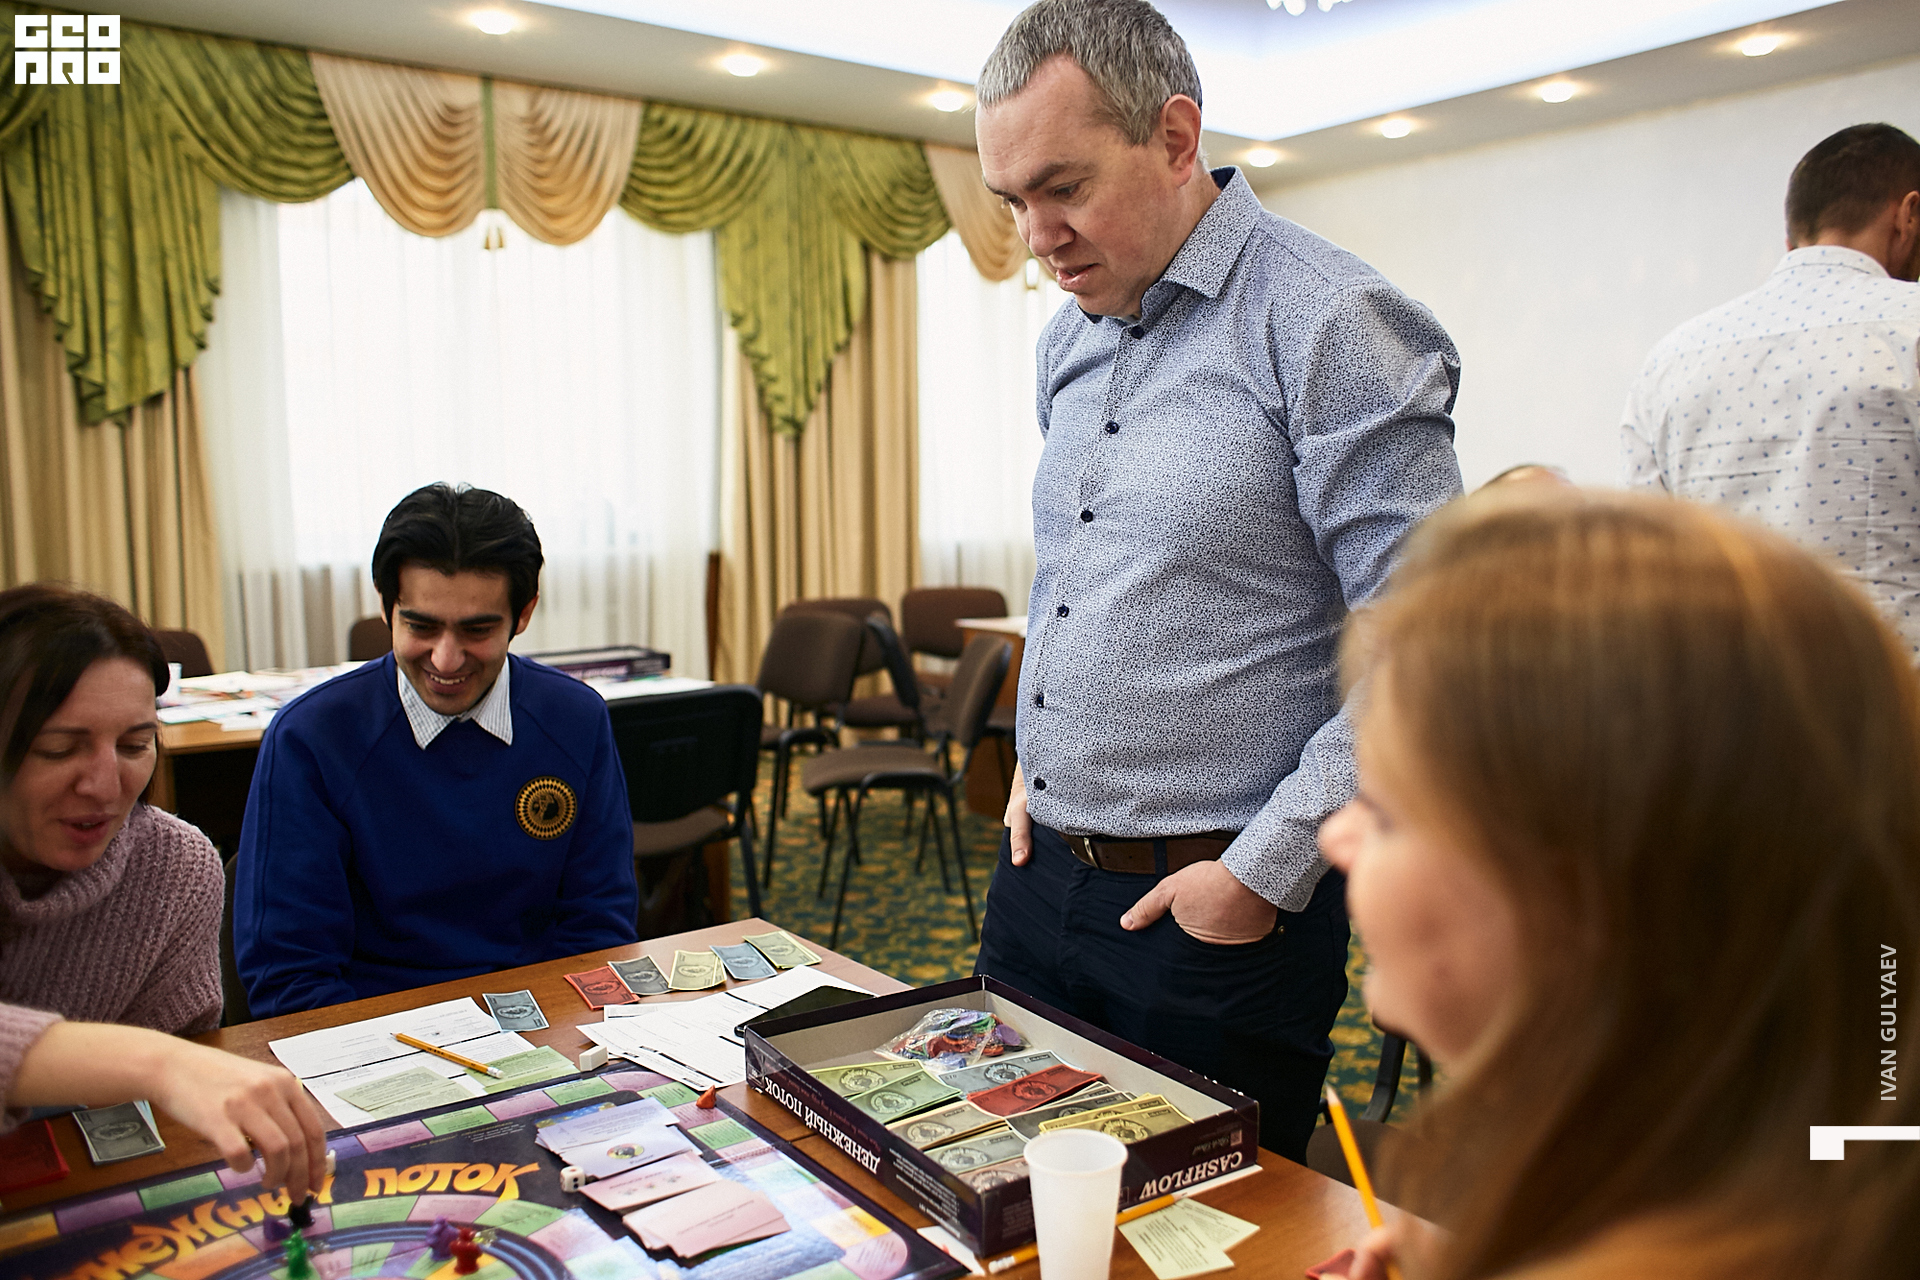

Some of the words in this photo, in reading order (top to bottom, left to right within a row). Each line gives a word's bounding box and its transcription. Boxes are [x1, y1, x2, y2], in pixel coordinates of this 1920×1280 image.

[764, 1076, 803, 1117] ПОТОК
[804, 1106, 880, 1174] ДЕНЕЖНЫЙ
[1138, 1151, 1242, 1200] CASHFLOW
